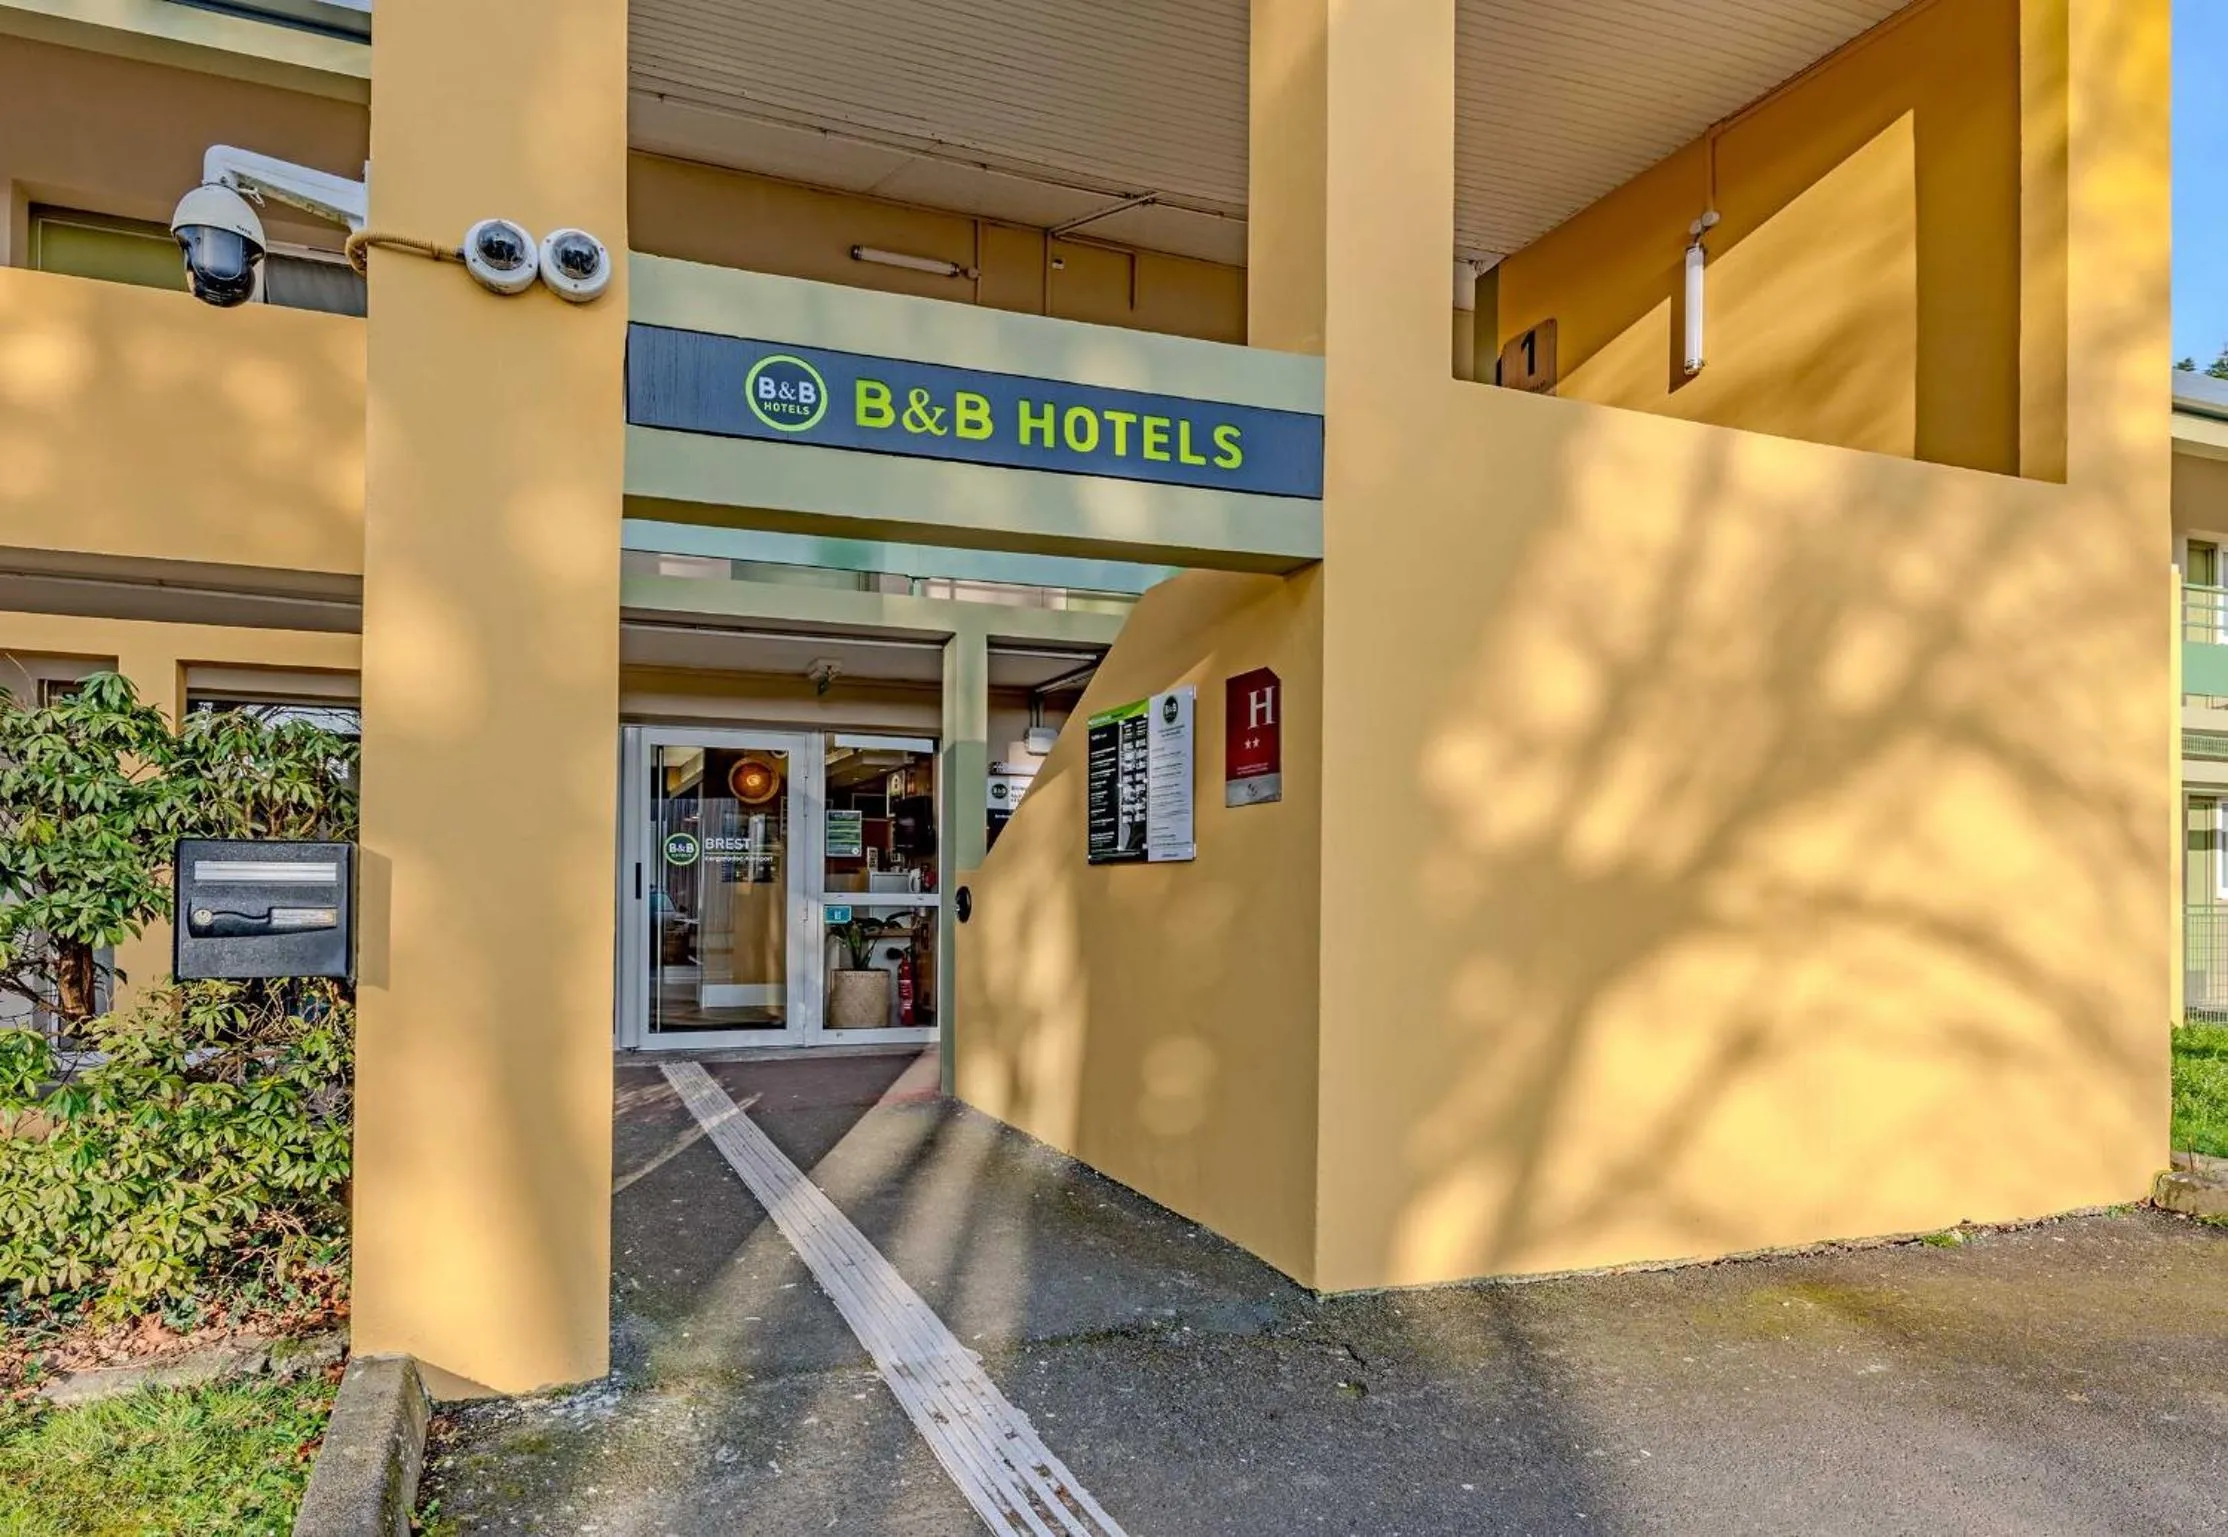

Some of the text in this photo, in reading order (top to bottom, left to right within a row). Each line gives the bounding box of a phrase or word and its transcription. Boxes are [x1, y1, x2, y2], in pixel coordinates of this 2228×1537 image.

[1520, 329, 1536, 377] 1
[758, 376, 816, 404] B&B
[763, 401, 811, 416] HOTELS
[855, 378, 1244, 470] B&B HOTELS
[1247, 685, 1277, 730] H
[669, 842, 695, 853] B&B
[704, 838, 752, 850] BREST
